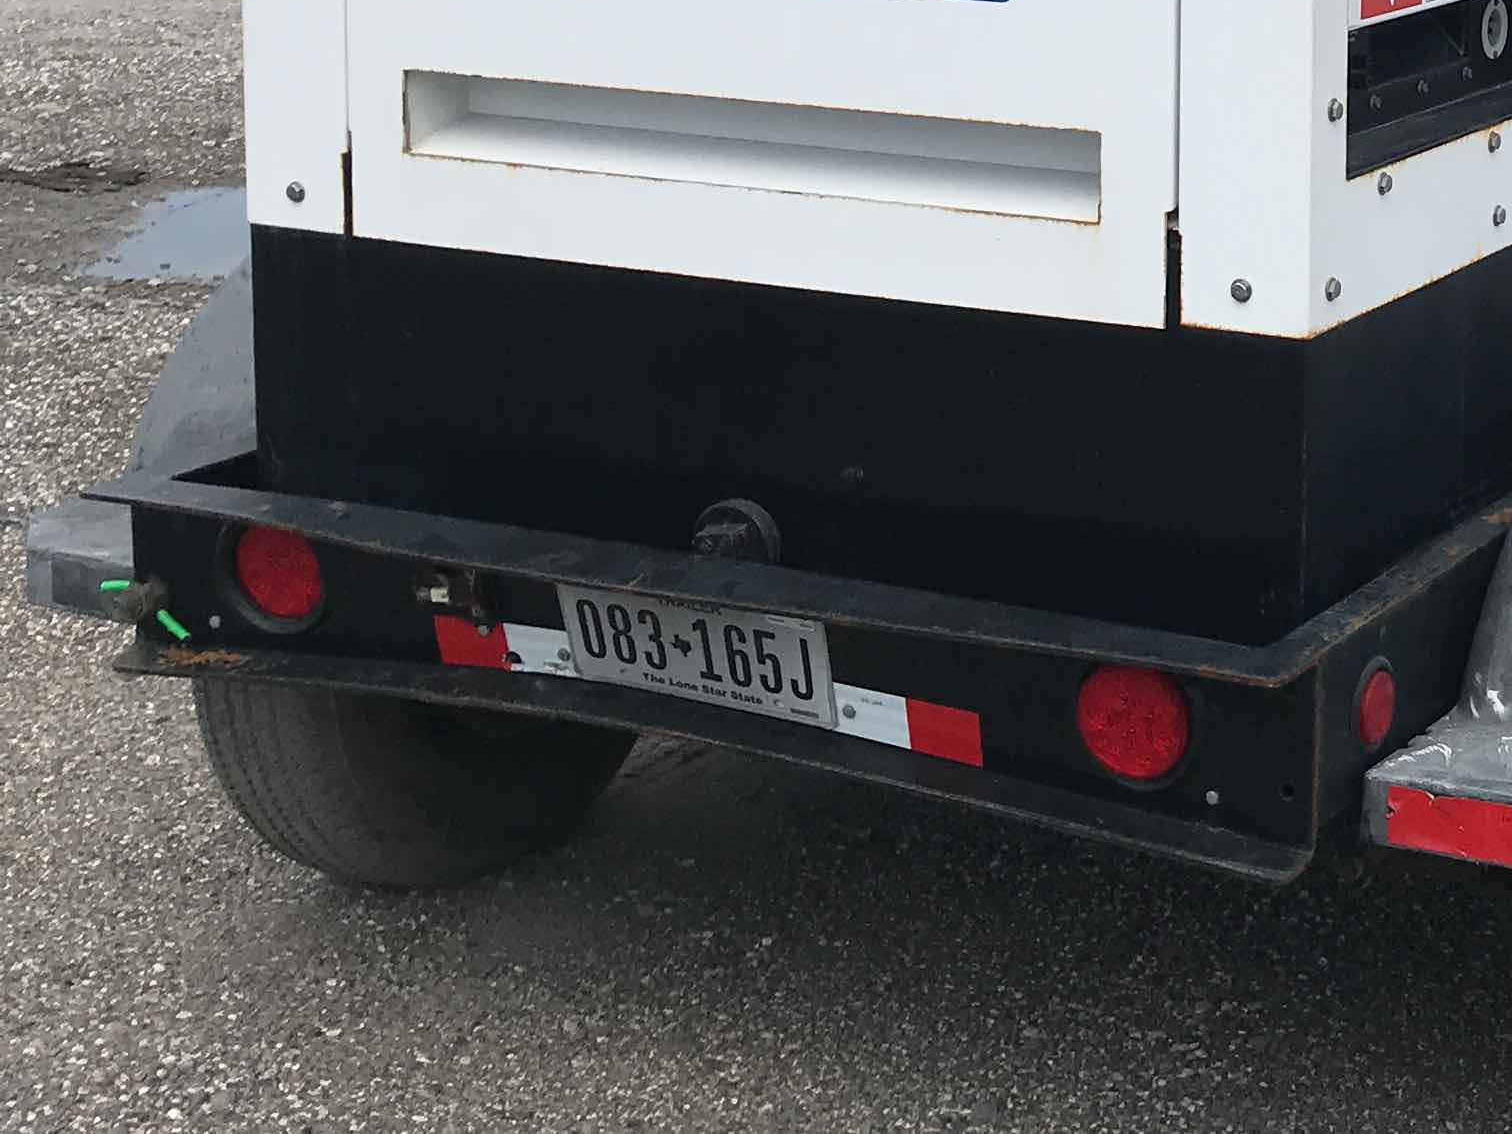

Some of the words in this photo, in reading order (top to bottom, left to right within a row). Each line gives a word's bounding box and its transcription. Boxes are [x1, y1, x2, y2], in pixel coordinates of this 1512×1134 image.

[642, 671, 665, 685] The
[669, 675, 699, 692] Lone
[702, 685, 728, 699] Star
[730, 689, 764, 706] State
